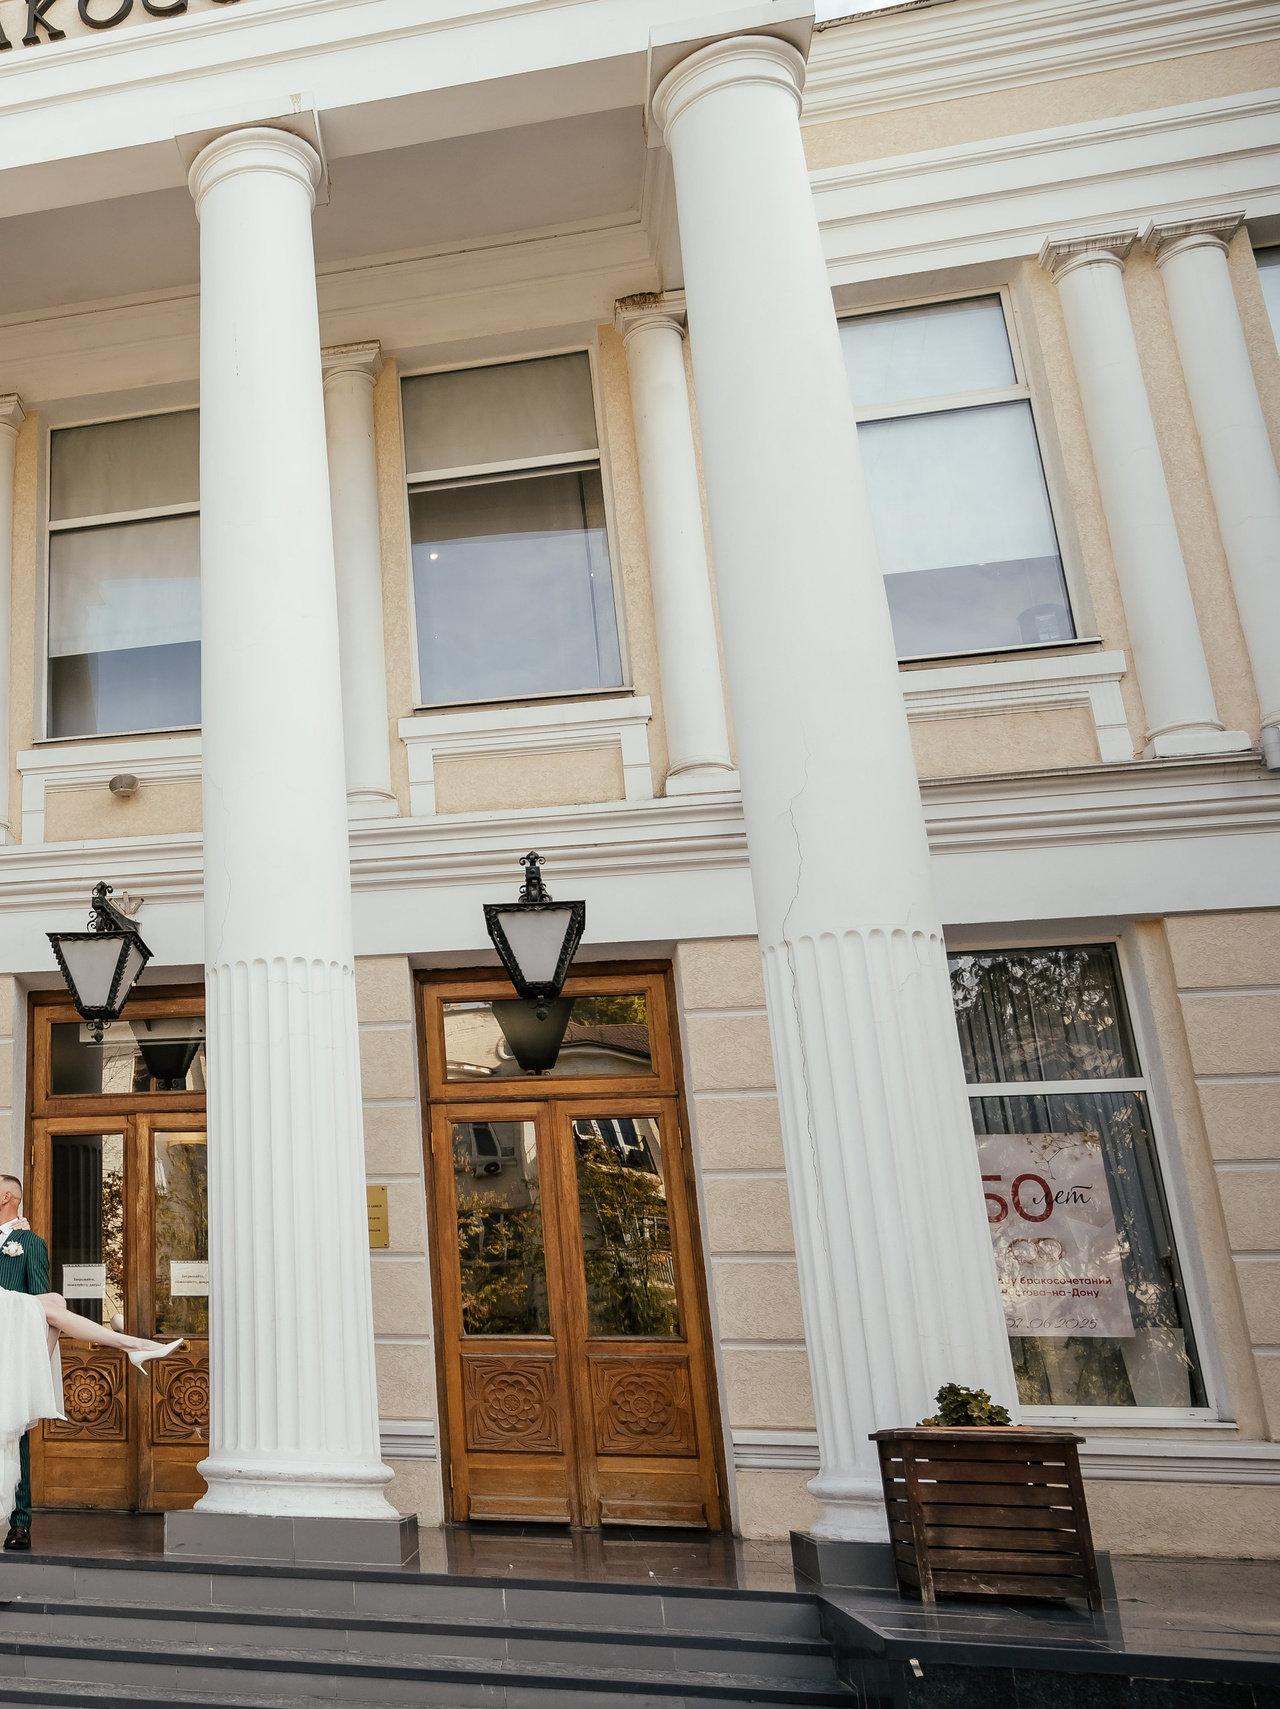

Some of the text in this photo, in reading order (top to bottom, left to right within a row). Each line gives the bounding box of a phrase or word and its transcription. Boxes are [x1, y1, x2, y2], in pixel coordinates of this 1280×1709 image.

[981, 1173, 1094, 1223] 50 лет
[1020, 1276, 1112, 1288] бракосочетаний
